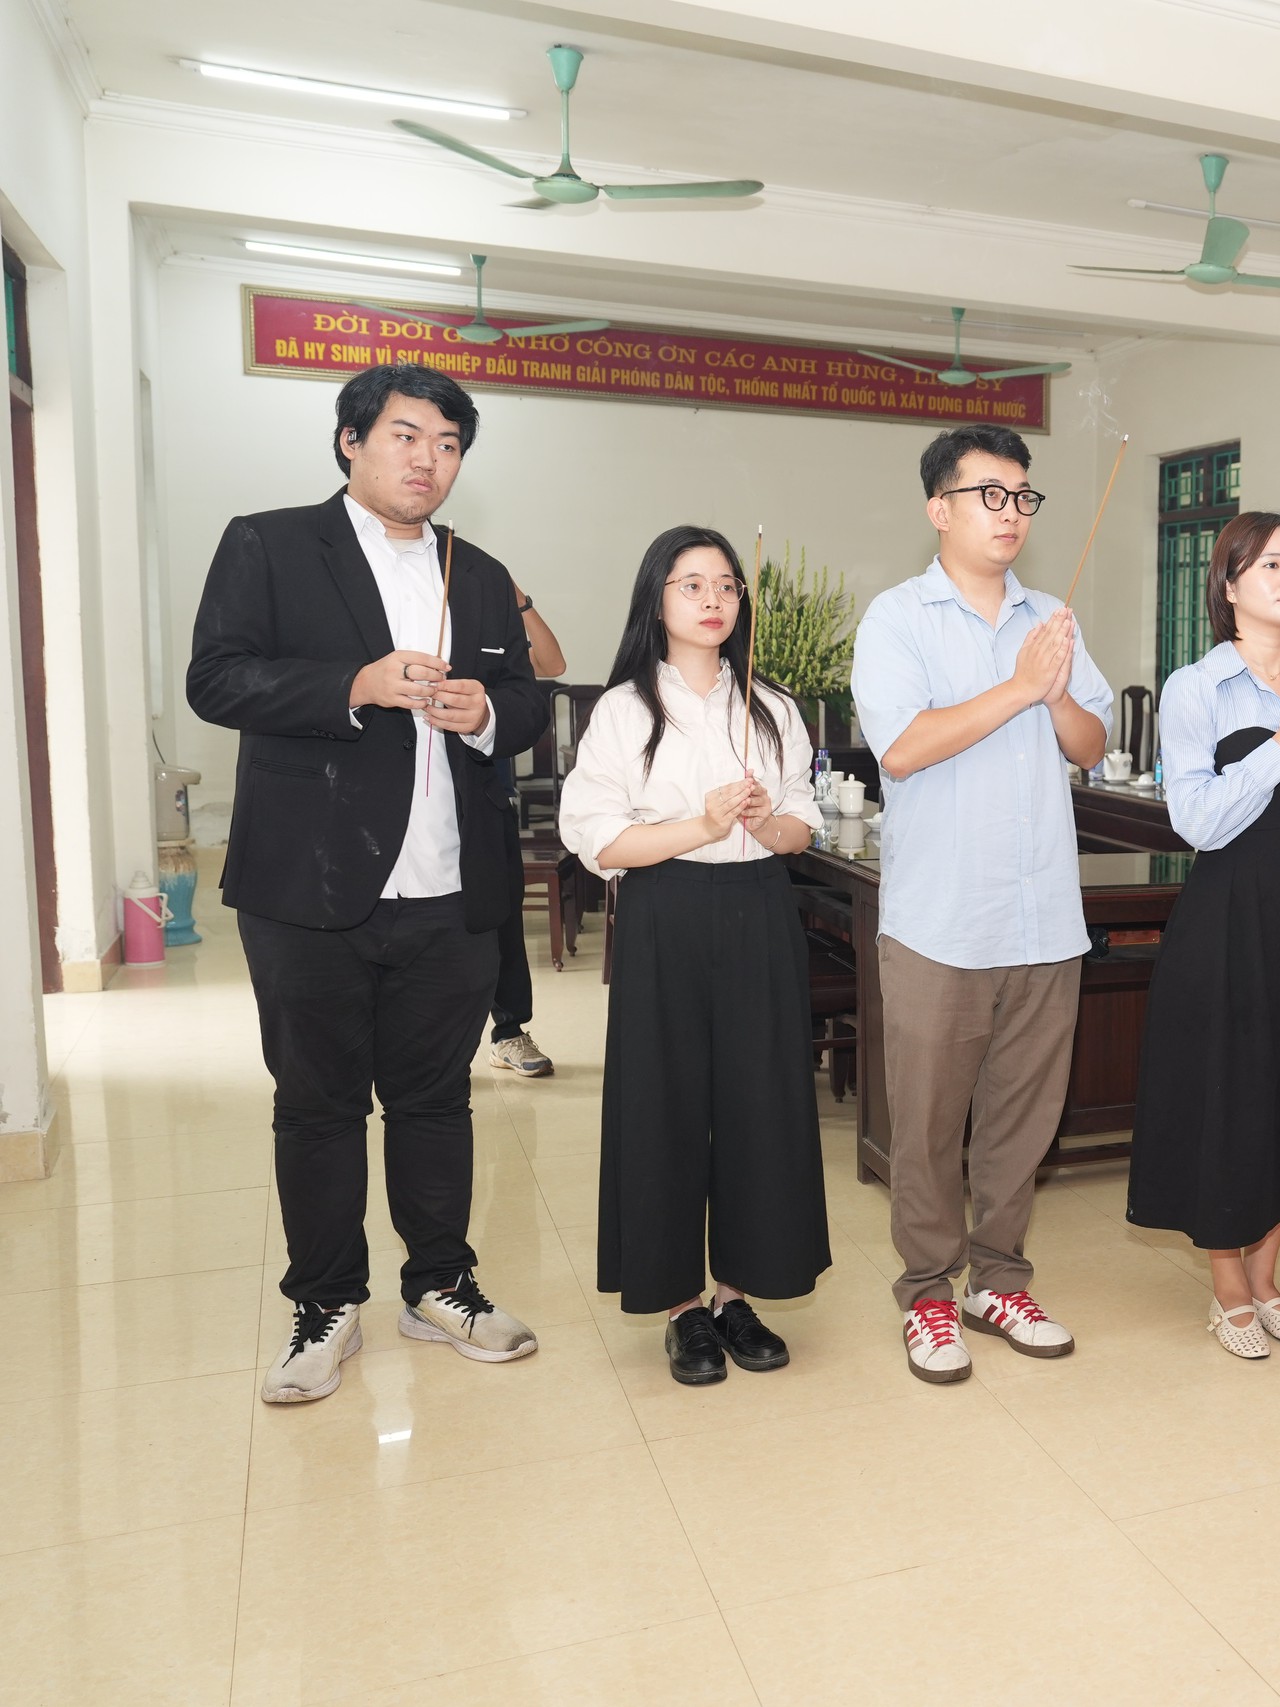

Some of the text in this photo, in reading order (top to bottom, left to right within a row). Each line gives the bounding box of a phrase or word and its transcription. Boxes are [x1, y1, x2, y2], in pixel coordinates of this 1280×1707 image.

[275, 336, 300, 359] ĐÃ
[304, 341, 326, 360] HY
[331, 343, 371, 364] SINH
[376, 344, 392, 364] VÌ
[423, 351, 481, 375] NGHIỆP
[486, 353, 517, 376] ĐẤU
[522, 360, 571, 381] TRANH
[576, 361, 606, 384] GIẢI
[611, 366, 660, 388] PHÓNG
[665, 370, 694, 391] DÂN
[699, 373, 730, 396] TỘC,
[734, 376, 779, 398] THỐNG
[783, 379, 818, 400] NHẤT
[821, 381, 838, 402] TỔ
[841, 385, 876, 406] QUỐC
[880, 389, 897, 407] VÀ
[900, 391, 925, 410] XÂY
[928, 395, 963, 414] DỰNG
[966, 395, 990, 415] ĐẤT
[993, 399, 1026, 418] NƯỚC
[313, 310, 370, 335] ĐỜI
[379, 319, 434, 341] ĐỜI
[576, 336, 652, 360] CÔNG
[658, 345, 697, 364] ƠN
[705, 348, 755, 369] CÁC
[762, 356, 818, 375] ANH
[826, 358, 905, 385] HÙNG,
[914, 370, 965, 389] LI
